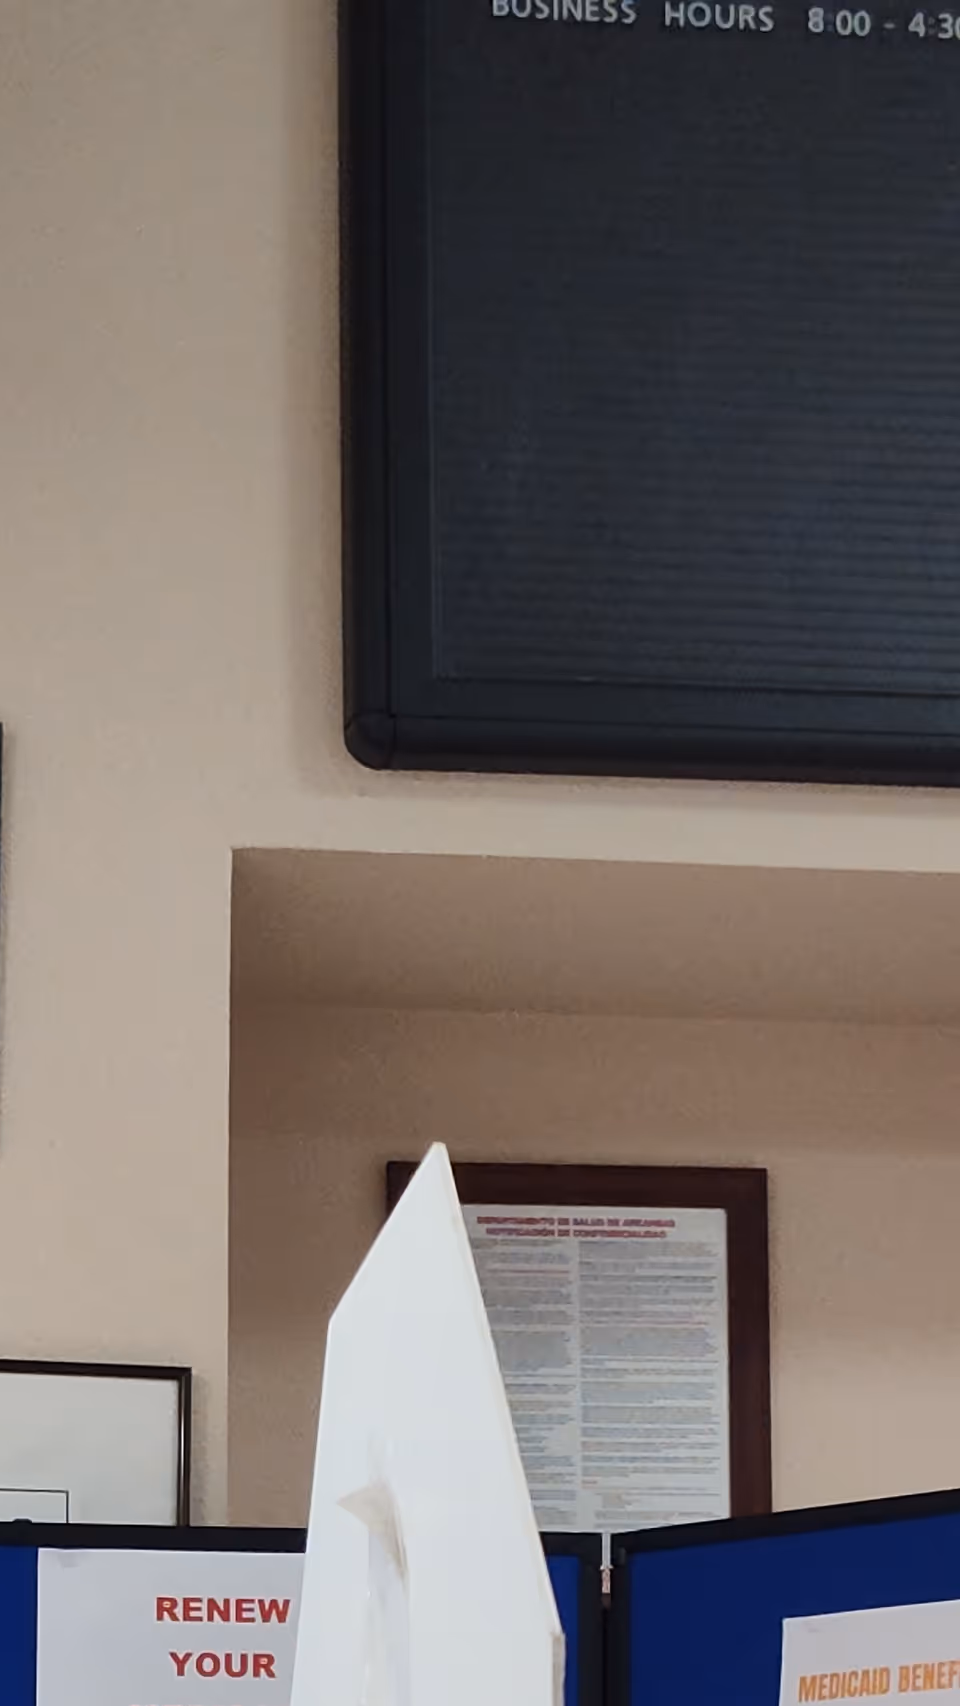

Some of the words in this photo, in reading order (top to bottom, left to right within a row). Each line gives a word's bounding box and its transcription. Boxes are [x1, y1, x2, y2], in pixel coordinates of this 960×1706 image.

[493, 0, 636, 24] BUSINESS
[665, 2, 773, 32] HOURS
[808, 7, 871, 36] 8:00
[156, 1597, 291, 1623] RENEW
[169, 1651, 277, 1678] YOUR
[798, 1666, 891, 1703] MEDICAID
